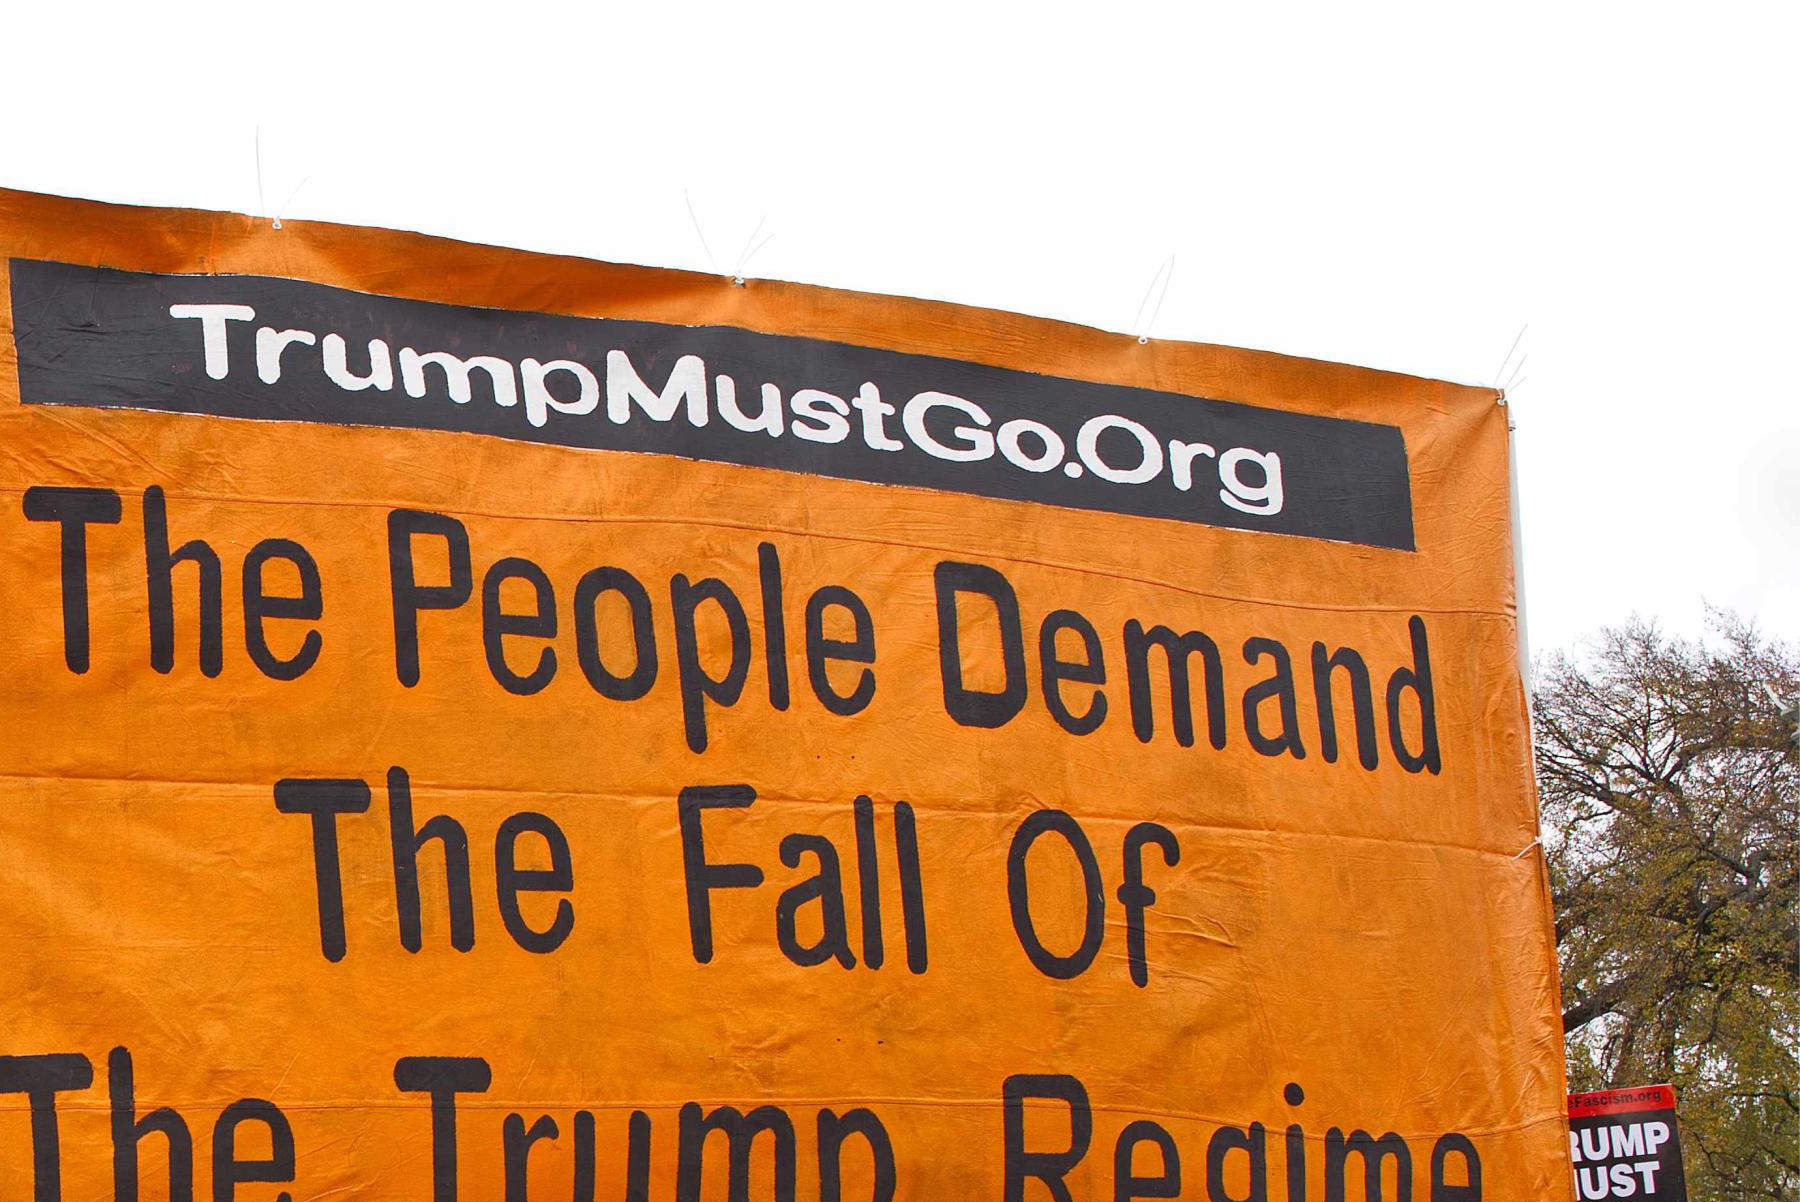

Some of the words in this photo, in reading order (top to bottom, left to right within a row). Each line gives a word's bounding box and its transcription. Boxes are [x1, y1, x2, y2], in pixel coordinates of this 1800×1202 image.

[170, 303, 1284, 516] TrumpMustGo.Org
[23, 484, 324, 683] The
[387, 508, 877, 754] People
[934, 560, 1442, 776] Demand
[273, 765, 576, 964] The
[676, 783, 930, 976] Fall
[1006, 808, 1181, 988] Of
[1568, 1090, 1662, 1109] eFascism.org
[1571, 1121, 1670, 1163] RUMP
[1577, 1160, 1660, 1201] UST
